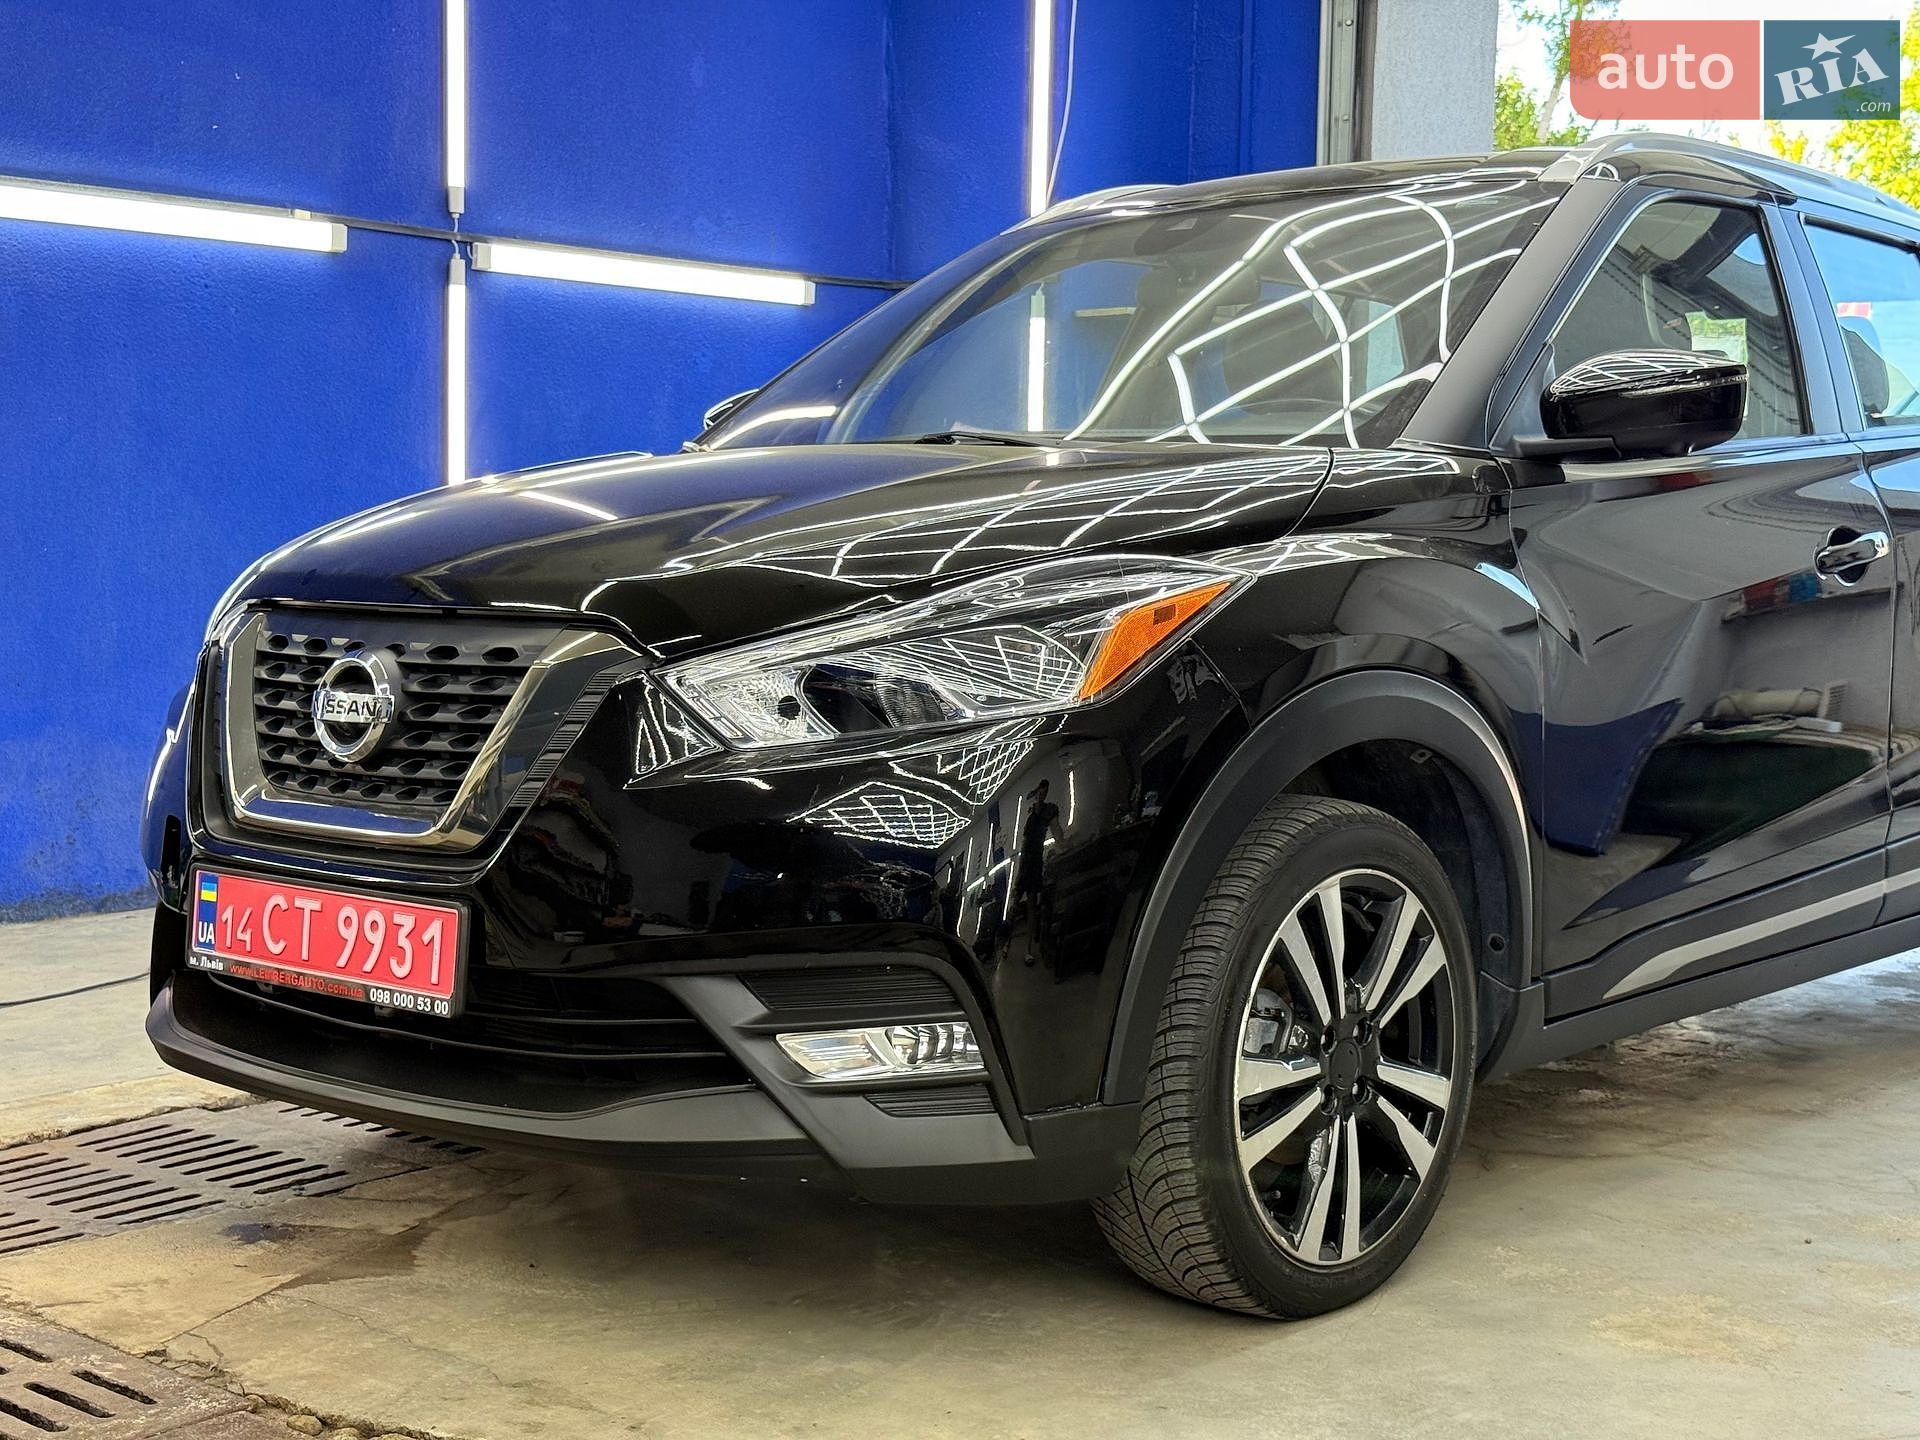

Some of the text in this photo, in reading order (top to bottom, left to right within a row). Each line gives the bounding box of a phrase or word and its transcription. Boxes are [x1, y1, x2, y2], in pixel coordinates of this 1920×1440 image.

[198, 920, 216, 945] UA
[221, 894, 444, 985] 14 CT 9931
[200, 956, 224, 971] Львів
[369, 988, 449, 1015] 098 000 53 00
